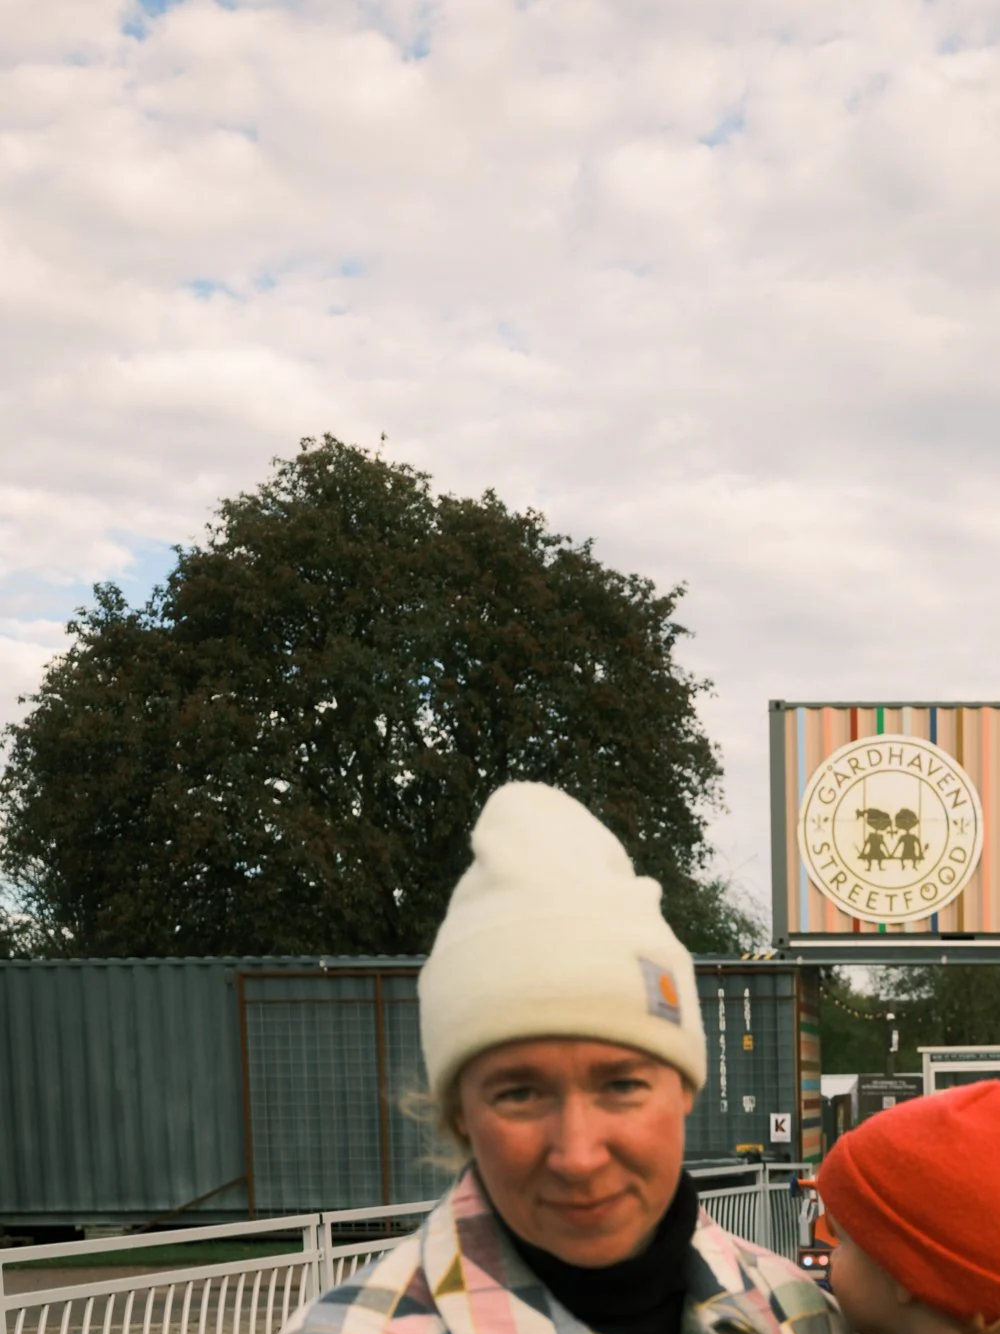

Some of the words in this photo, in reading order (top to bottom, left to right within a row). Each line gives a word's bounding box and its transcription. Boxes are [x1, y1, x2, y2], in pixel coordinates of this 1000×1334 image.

[818, 746, 967, 809] GÅRDHAVEN
[812, 841, 967, 912] STREETFOOD
[774, 1117, 787, 1133] K
